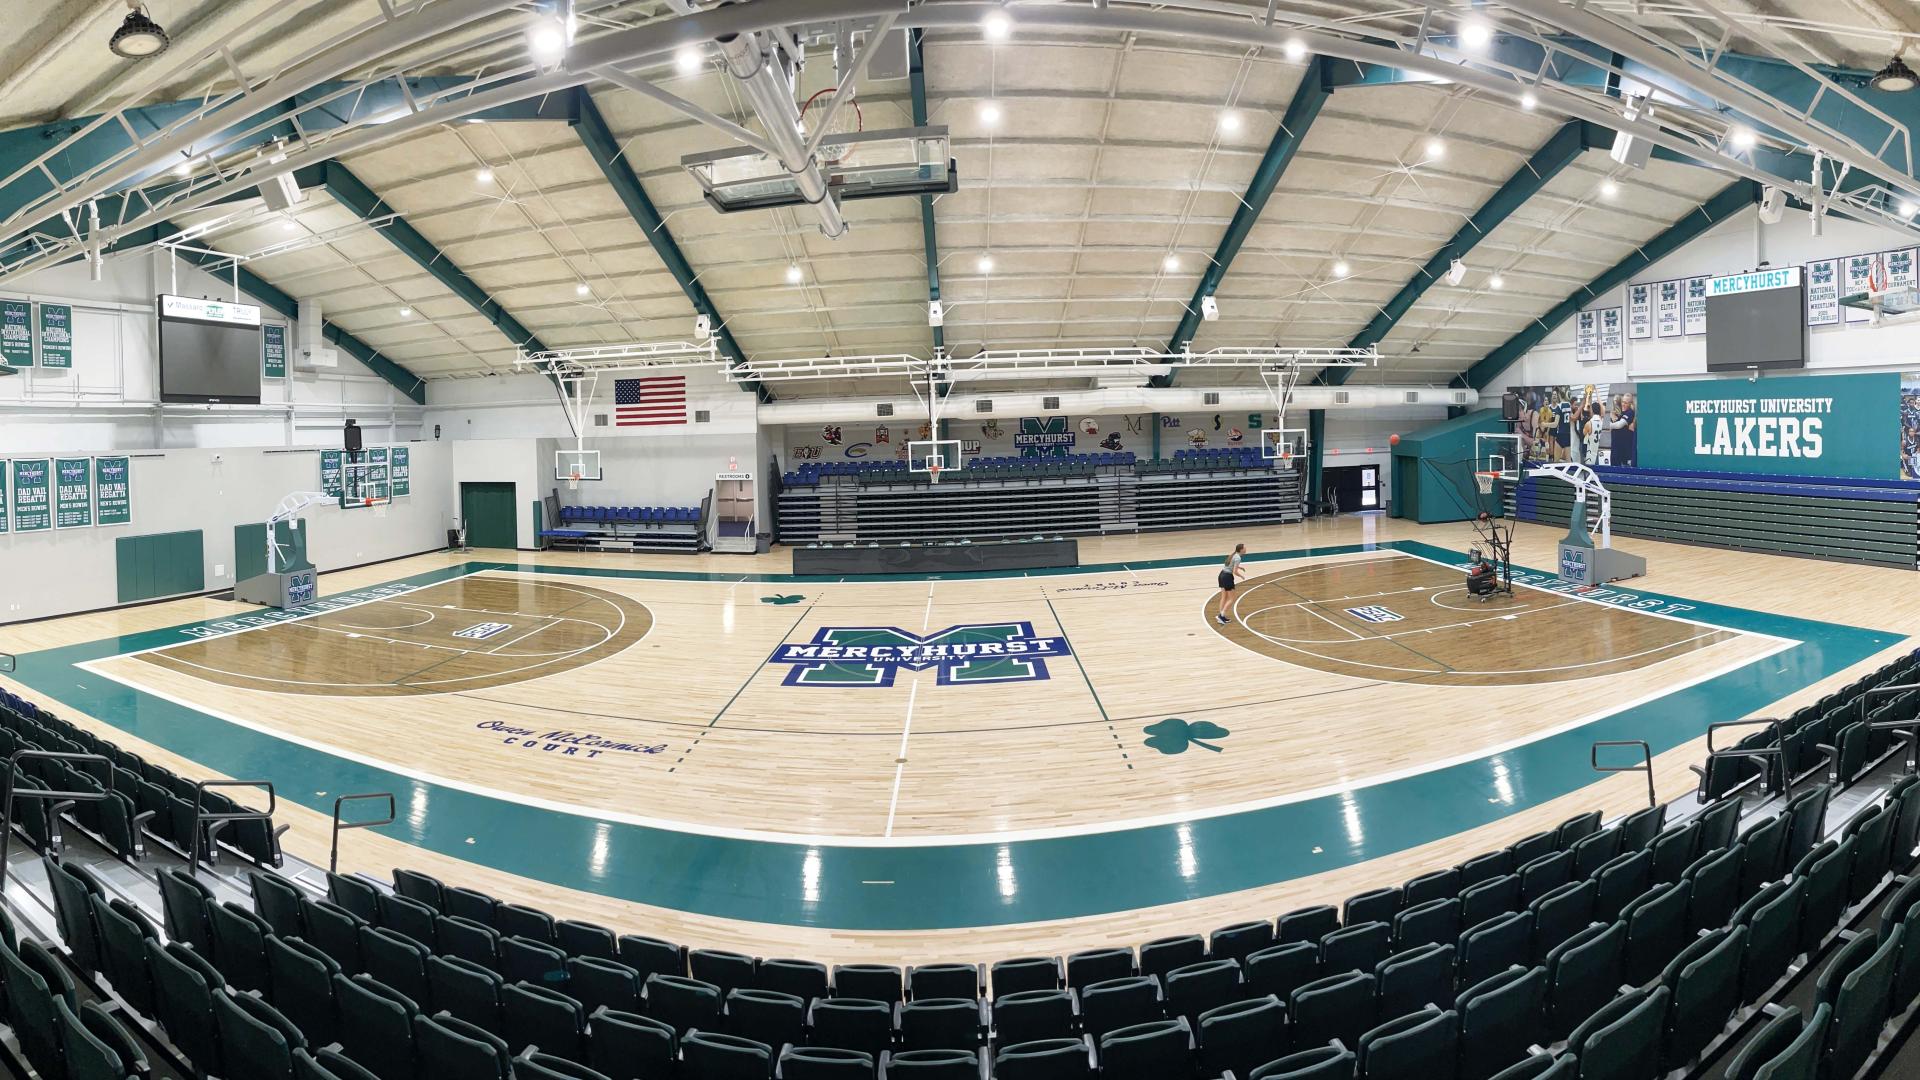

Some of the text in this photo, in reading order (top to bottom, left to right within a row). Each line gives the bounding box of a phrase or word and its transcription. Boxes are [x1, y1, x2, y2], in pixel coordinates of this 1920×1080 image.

[1713, 270, 1790, 294] MERCYHURST
[1810, 286, 1835, 294] NATIONAL
[1809, 293, 1836, 302] CHAMPION
[1685, 397, 1833, 414] MERCYHURST UNIVERSITY
[1160, 416, 1180, 428] Pitt
[1015, 433, 1074, 444] MERCYHURST
[1694, 417, 1823, 459] LAKERS
[17, 487, 47, 496] DAD VAIL
[60, 485, 88, 493] DAD VAIL
[18, 495, 47, 504] REGATTA
[60, 492, 87, 500] REGATTA
[100, 490, 126, 499] REGATTA
[783, 639, 1054, 658] MERCYHURST
[873, 653, 967, 663] UNIVERSITY
[476, 720, 668, 755] Owen McCormick
[503, 737, 603, 758] COURT
